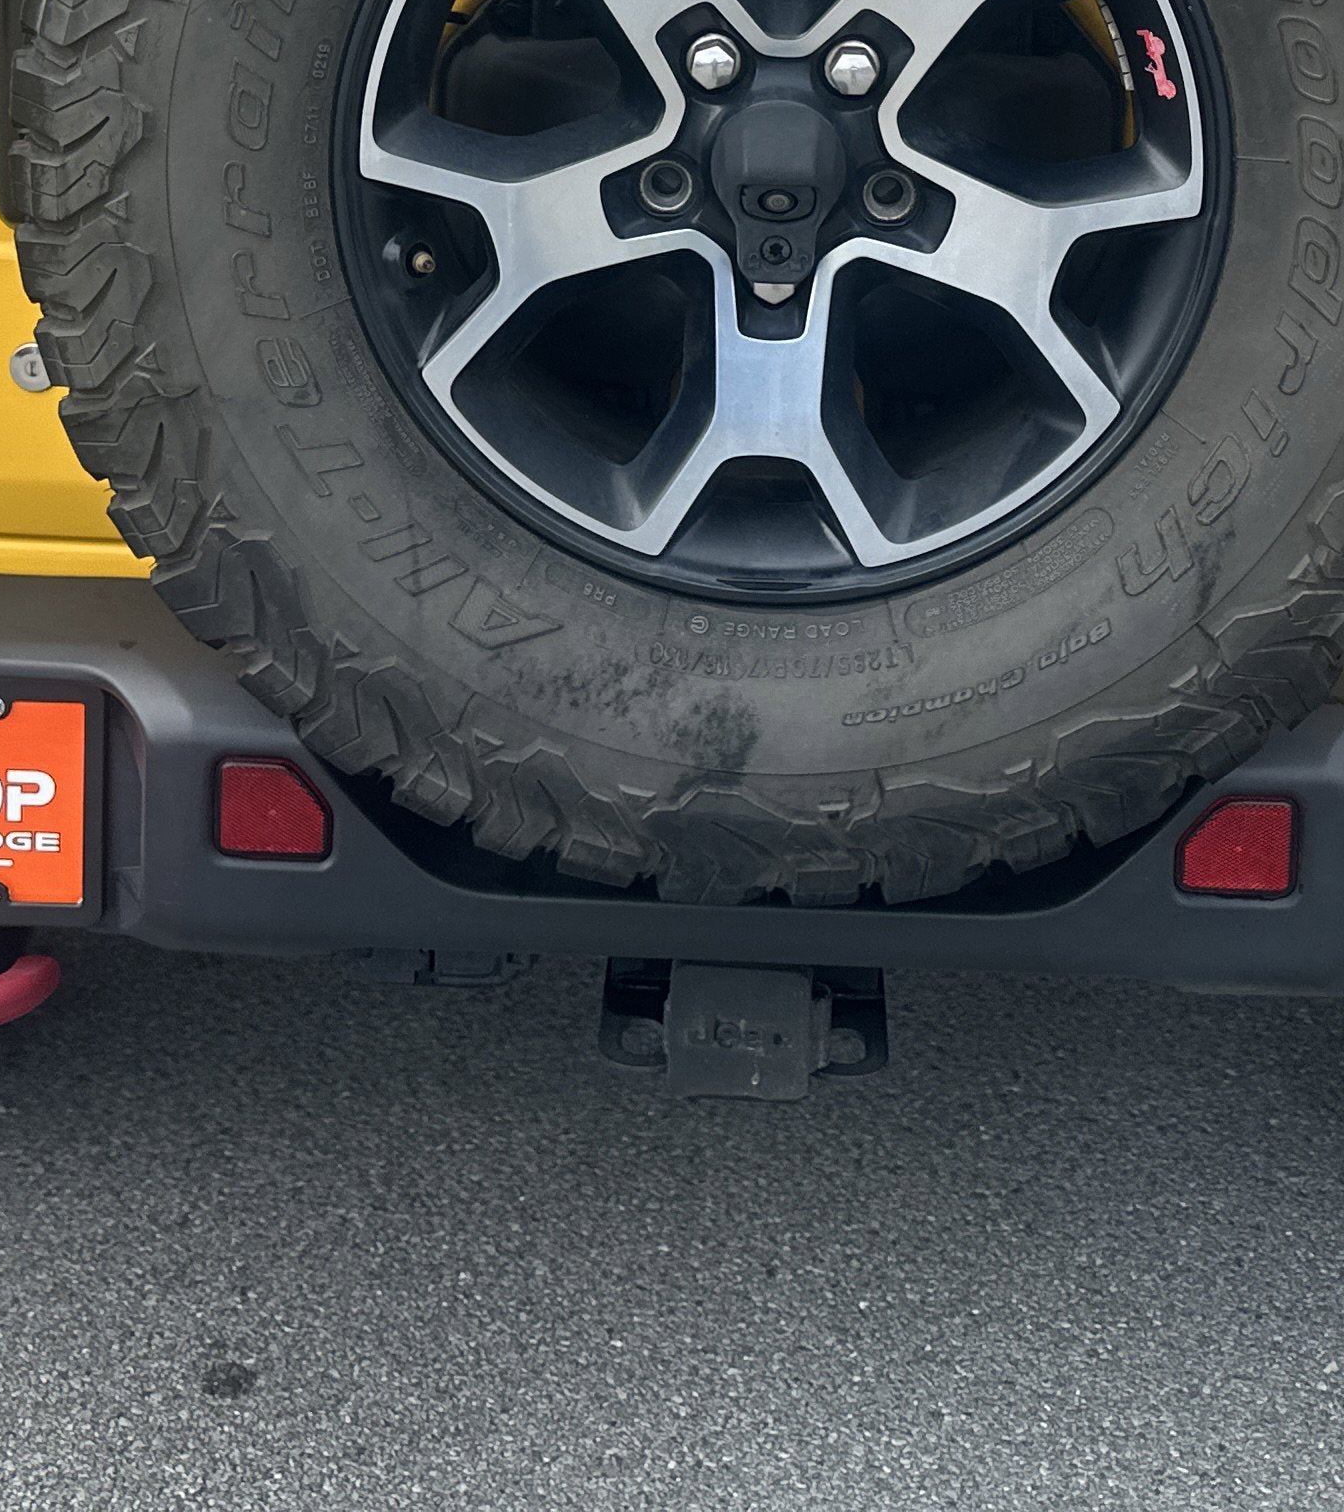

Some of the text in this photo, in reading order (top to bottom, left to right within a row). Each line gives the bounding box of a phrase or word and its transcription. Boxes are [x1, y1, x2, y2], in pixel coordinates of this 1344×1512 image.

[722, 621, 795, 639] RANGE
[803, 618, 864, 639] LOAD
[843, 617, 1113, 727] Baja Champion
